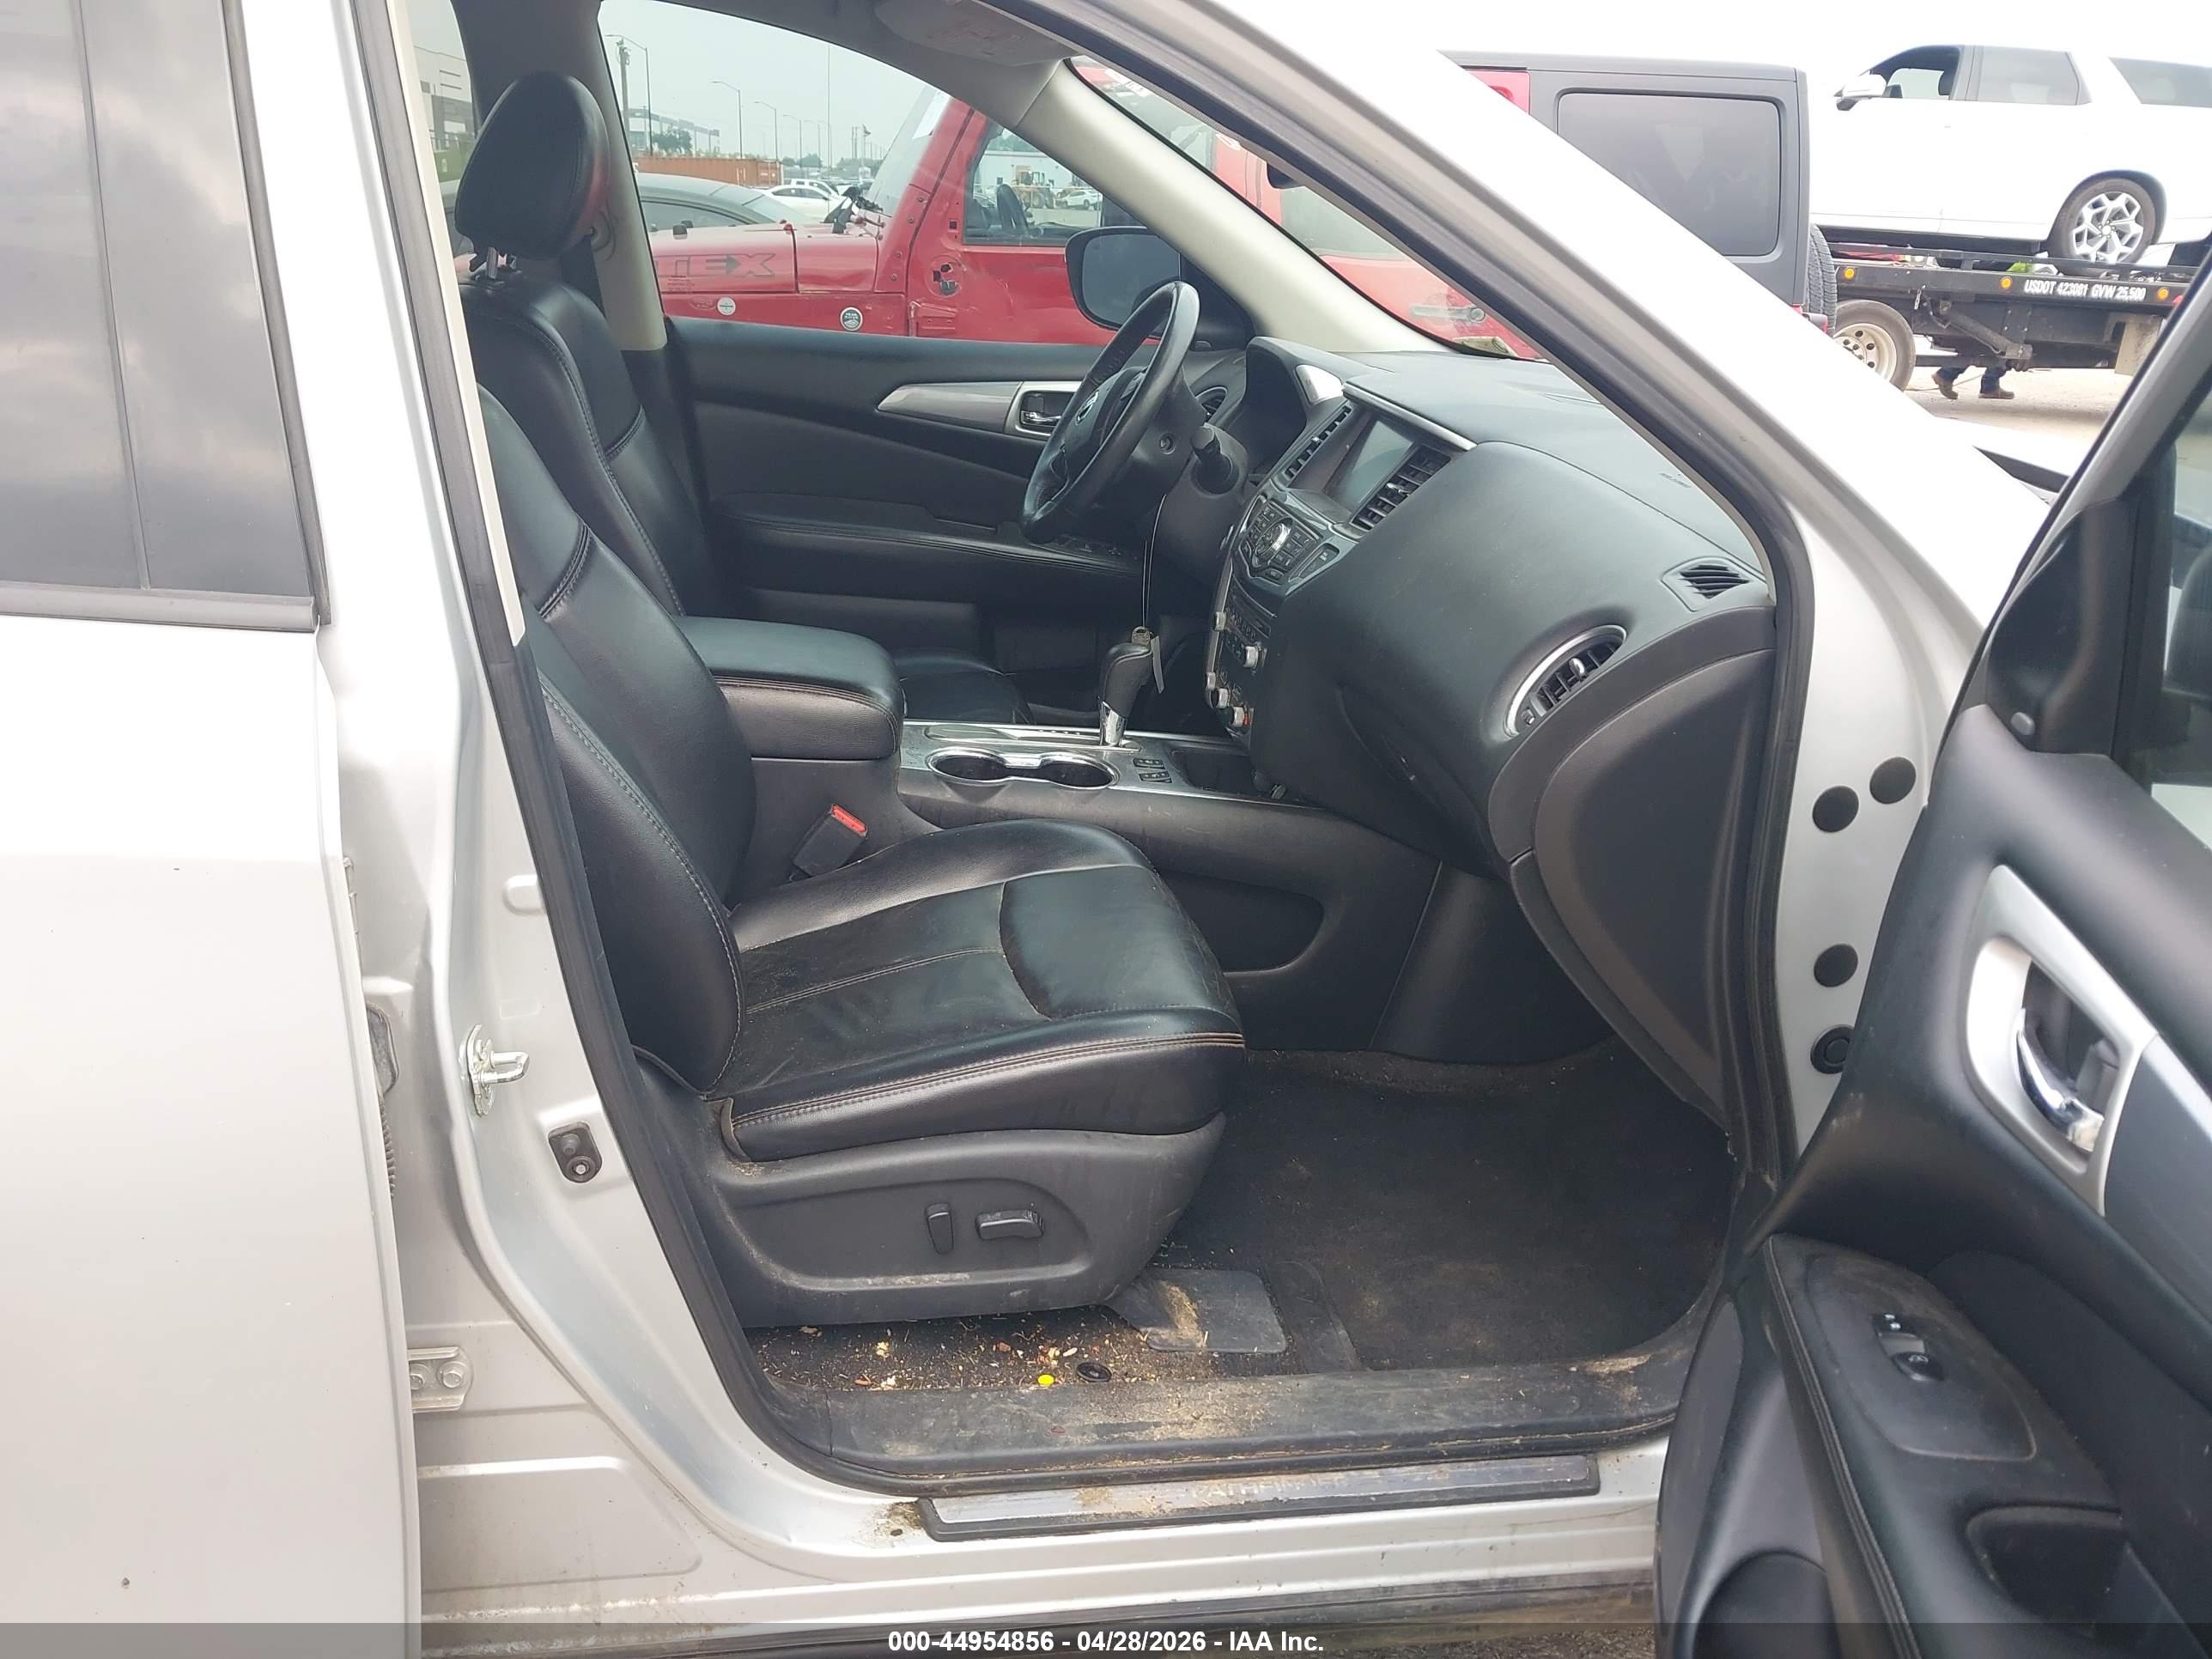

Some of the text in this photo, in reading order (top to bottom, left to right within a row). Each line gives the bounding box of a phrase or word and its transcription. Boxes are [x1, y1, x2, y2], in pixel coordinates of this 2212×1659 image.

[2024, 279, 2057, 295] USDOT
[2091, 284, 2116, 299] GVW
[2116, 286, 2147, 301] 25,500
